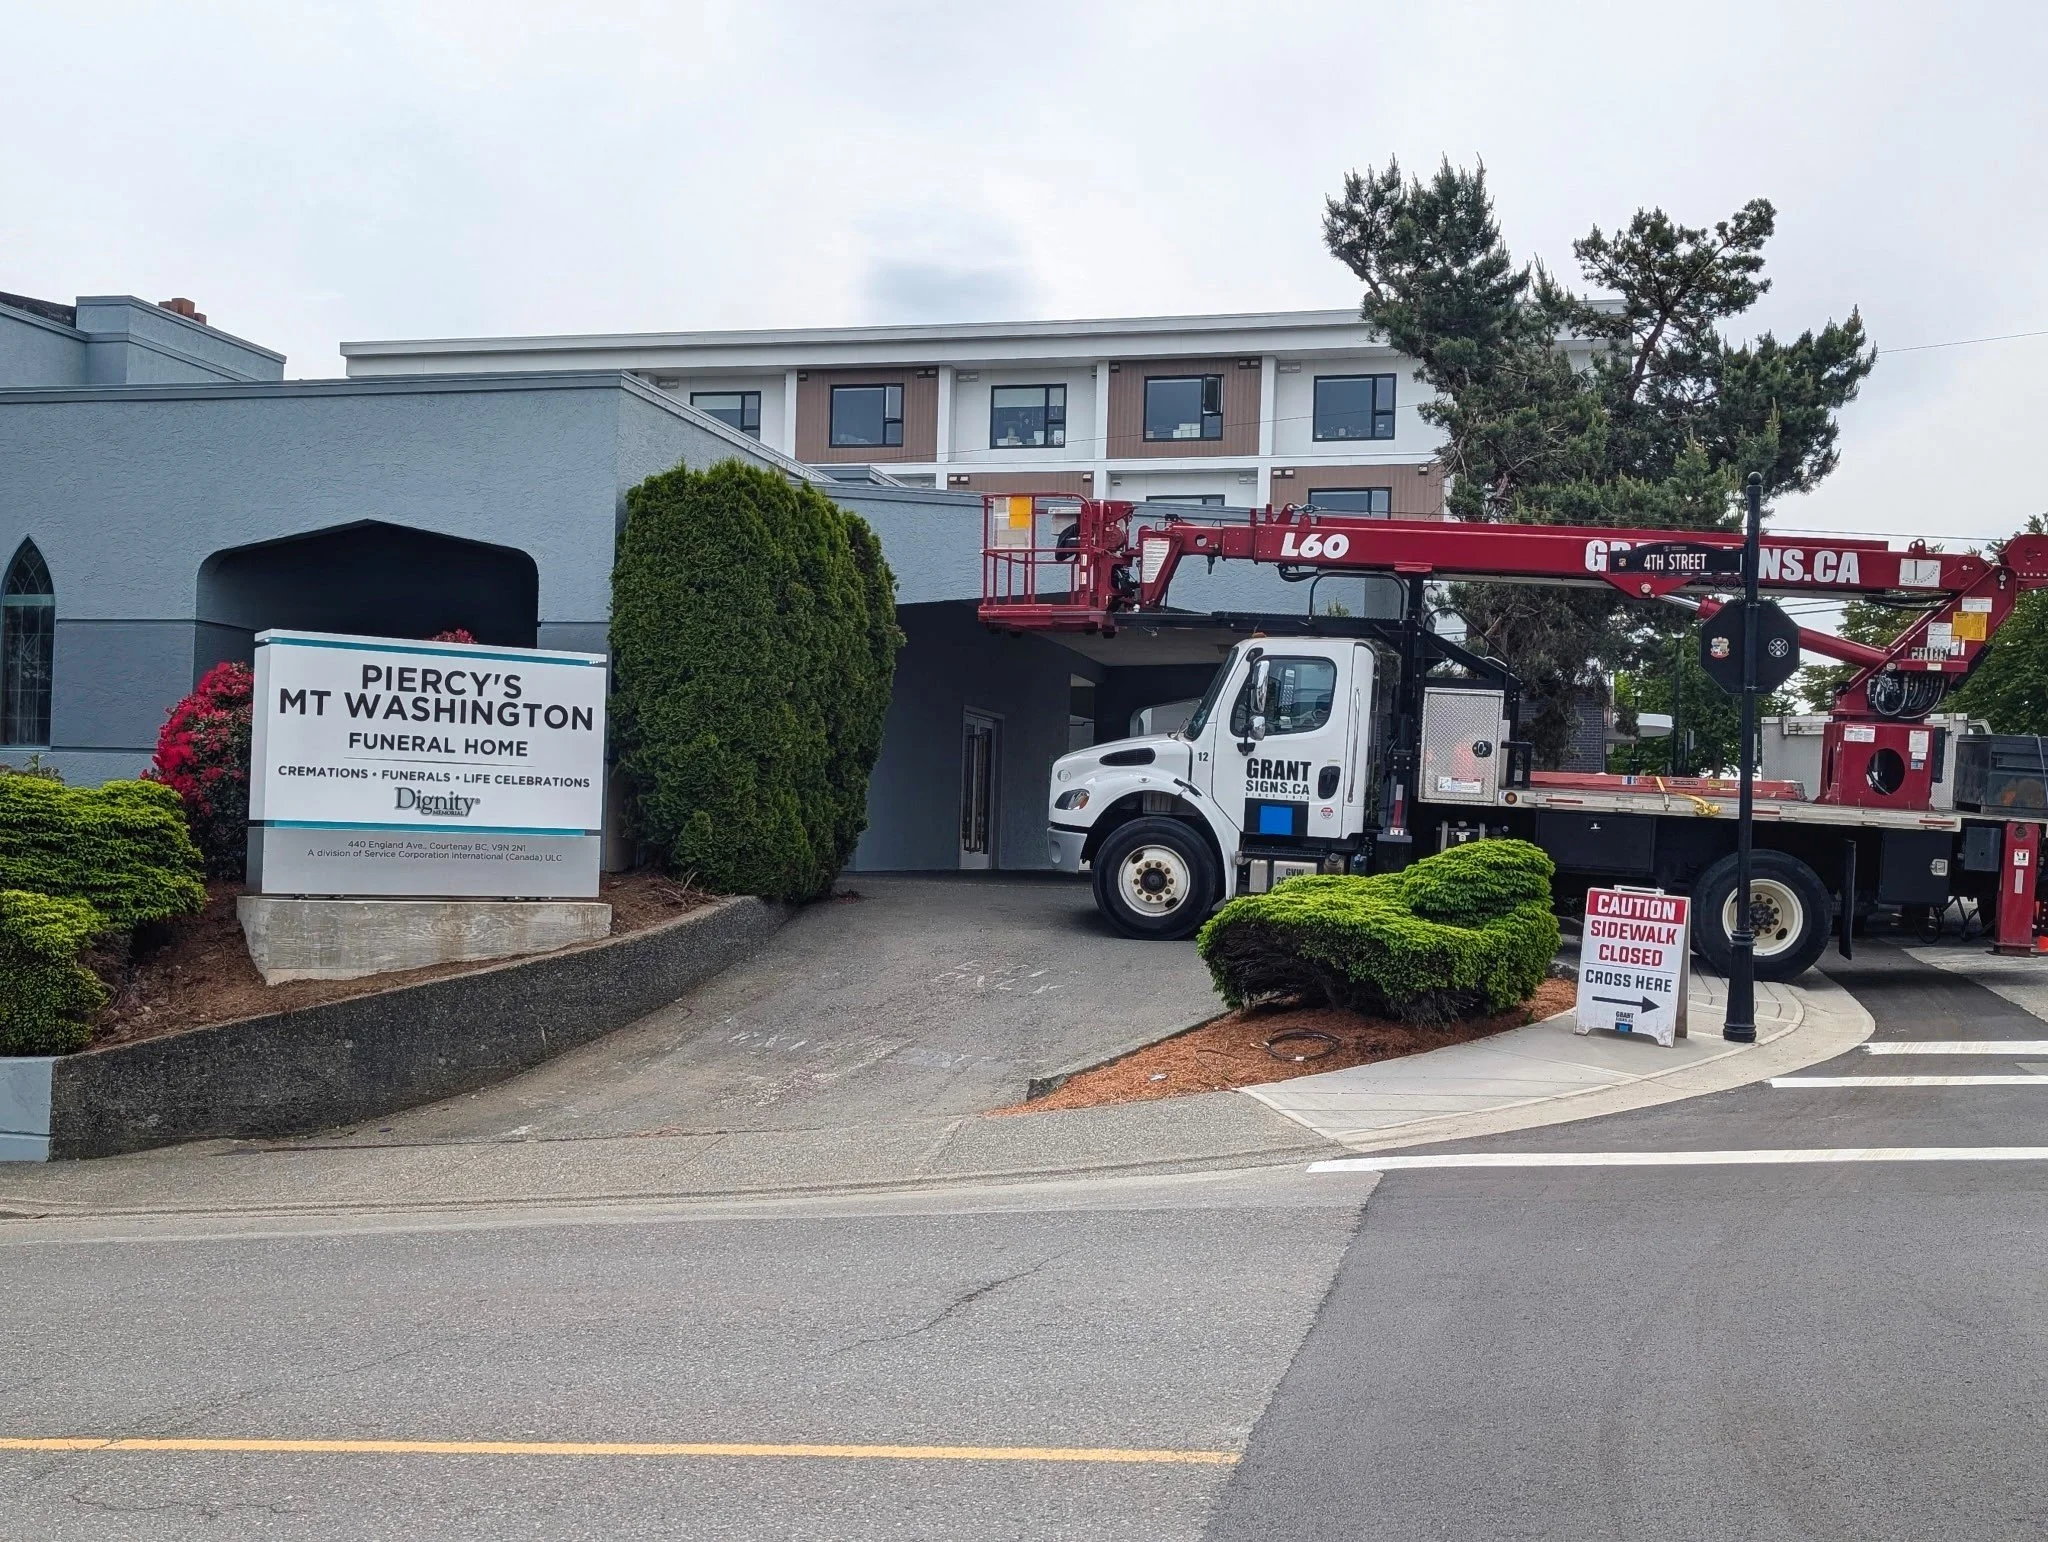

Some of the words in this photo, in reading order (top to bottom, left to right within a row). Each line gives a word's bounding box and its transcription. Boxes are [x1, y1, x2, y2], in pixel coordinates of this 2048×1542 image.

[1280, 532, 1350, 559] L60
[1643, 554, 1664, 571] 4TH
[1668, 553, 1707, 570] STREET
[362, 664, 522, 699] PIERCY'S
[279, 688, 331, 716] MT
[344, 692, 594, 731] WASHINGTON
[349, 732, 456, 753] FUNERAL
[465, 738, 528, 757] HOME
[1198, 752, 1209, 762] 12
[278, 765, 368, 779] CREMATIONS
[381, 770, 450, 782] FUNERALS
[463, 773, 490, 784] LIFE
[494, 774, 590, 788] CELEBRATIONS
[1246, 757, 1312, 782] GRANT
[1245, 779, 1310, 795] SIGNS.CA
[307, 849, 315, 857] A
[317, 849, 351, 857] division
[364, 850, 396, 858] Service
[398, 850, 450, 860] Corporation
[452, 851, 504, 860] International
[505, 853, 543, 862] (Canada)
[545, 854, 562, 862] ULC
[348, 840, 366, 848] 440
[368, 840, 404, 850] England
[429, 842, 473, 852] Courtenay
[491, 844, 510, 852] V9N
[511, 844, 526, 852] 2N1
[1285, 867, 1305, 877] GVW
[1597, 894, 1676, 921] CAUTION
[1590, 919, 1678, 946] SIDEWALK
[1598, 943, 1663, 967] CLOSED
[1585, 969, 1631, 989] CROSS
[1635, 975, 1673, 993] HERE
